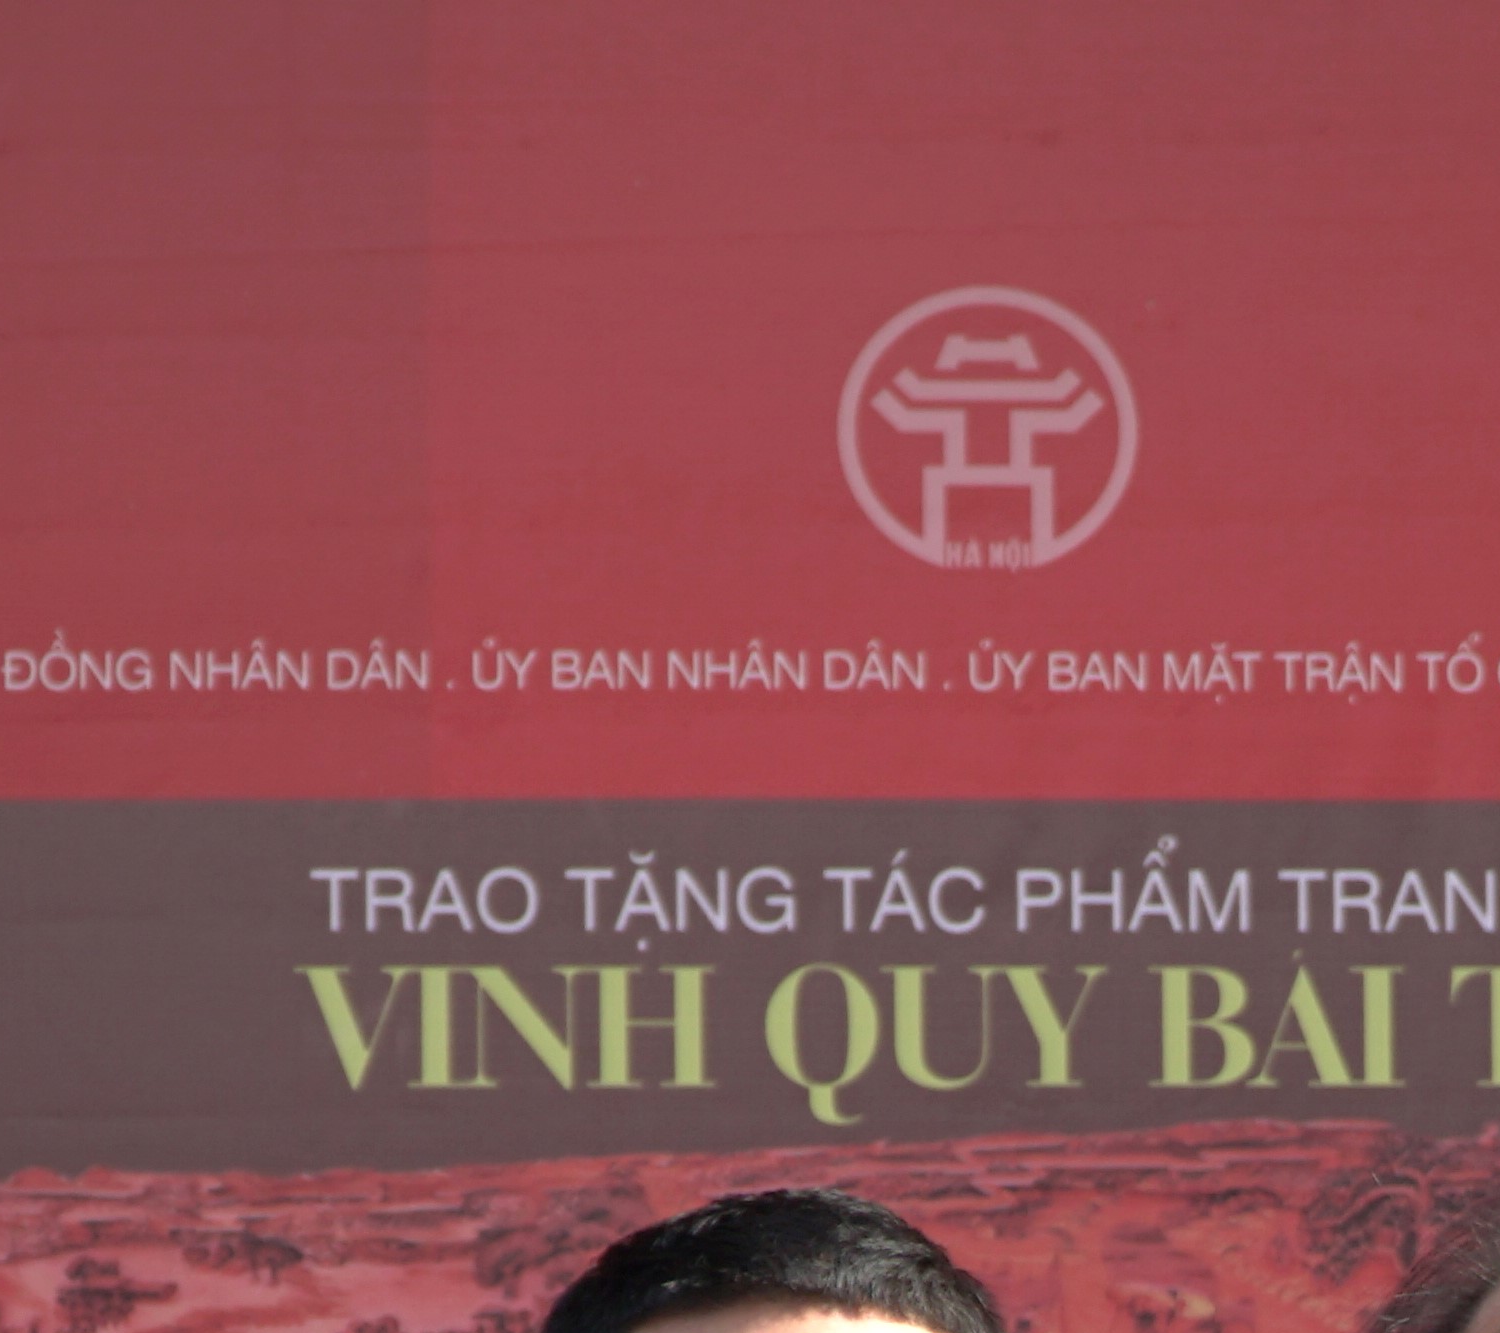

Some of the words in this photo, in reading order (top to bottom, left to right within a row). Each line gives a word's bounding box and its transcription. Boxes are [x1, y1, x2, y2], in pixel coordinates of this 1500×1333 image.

[0, 627, 157, 694] ĐỒNG
[168, 636, 314, 692] NHÂN
[325, 636, 432, 692] DÂN
[470, 635, 539, 692] ỦY
[549, 646, 654, 692] BAN
[665, 636, 810, 692] NHÂN
[821, 637, 929, 692] DÂN
[967, 636, 1036, 693] ỦY
[1046, 648, 1150, 693] BAN
[1161, 640, 1264, 704] MẶT
[1272, 640, 1406, 704] TRẬN
[1414, 630, 1488, 695] TỔ
[308, 864, 541, 935] TRAO
[562, 849, 799, 950] TẶNG
[821, 847, 987, 936] TÁC
[1014, 833, 1252, 934] PHẨM
[293, 962, 718, 1091] VINH
[762, 960, 1110, 1126] QUY
